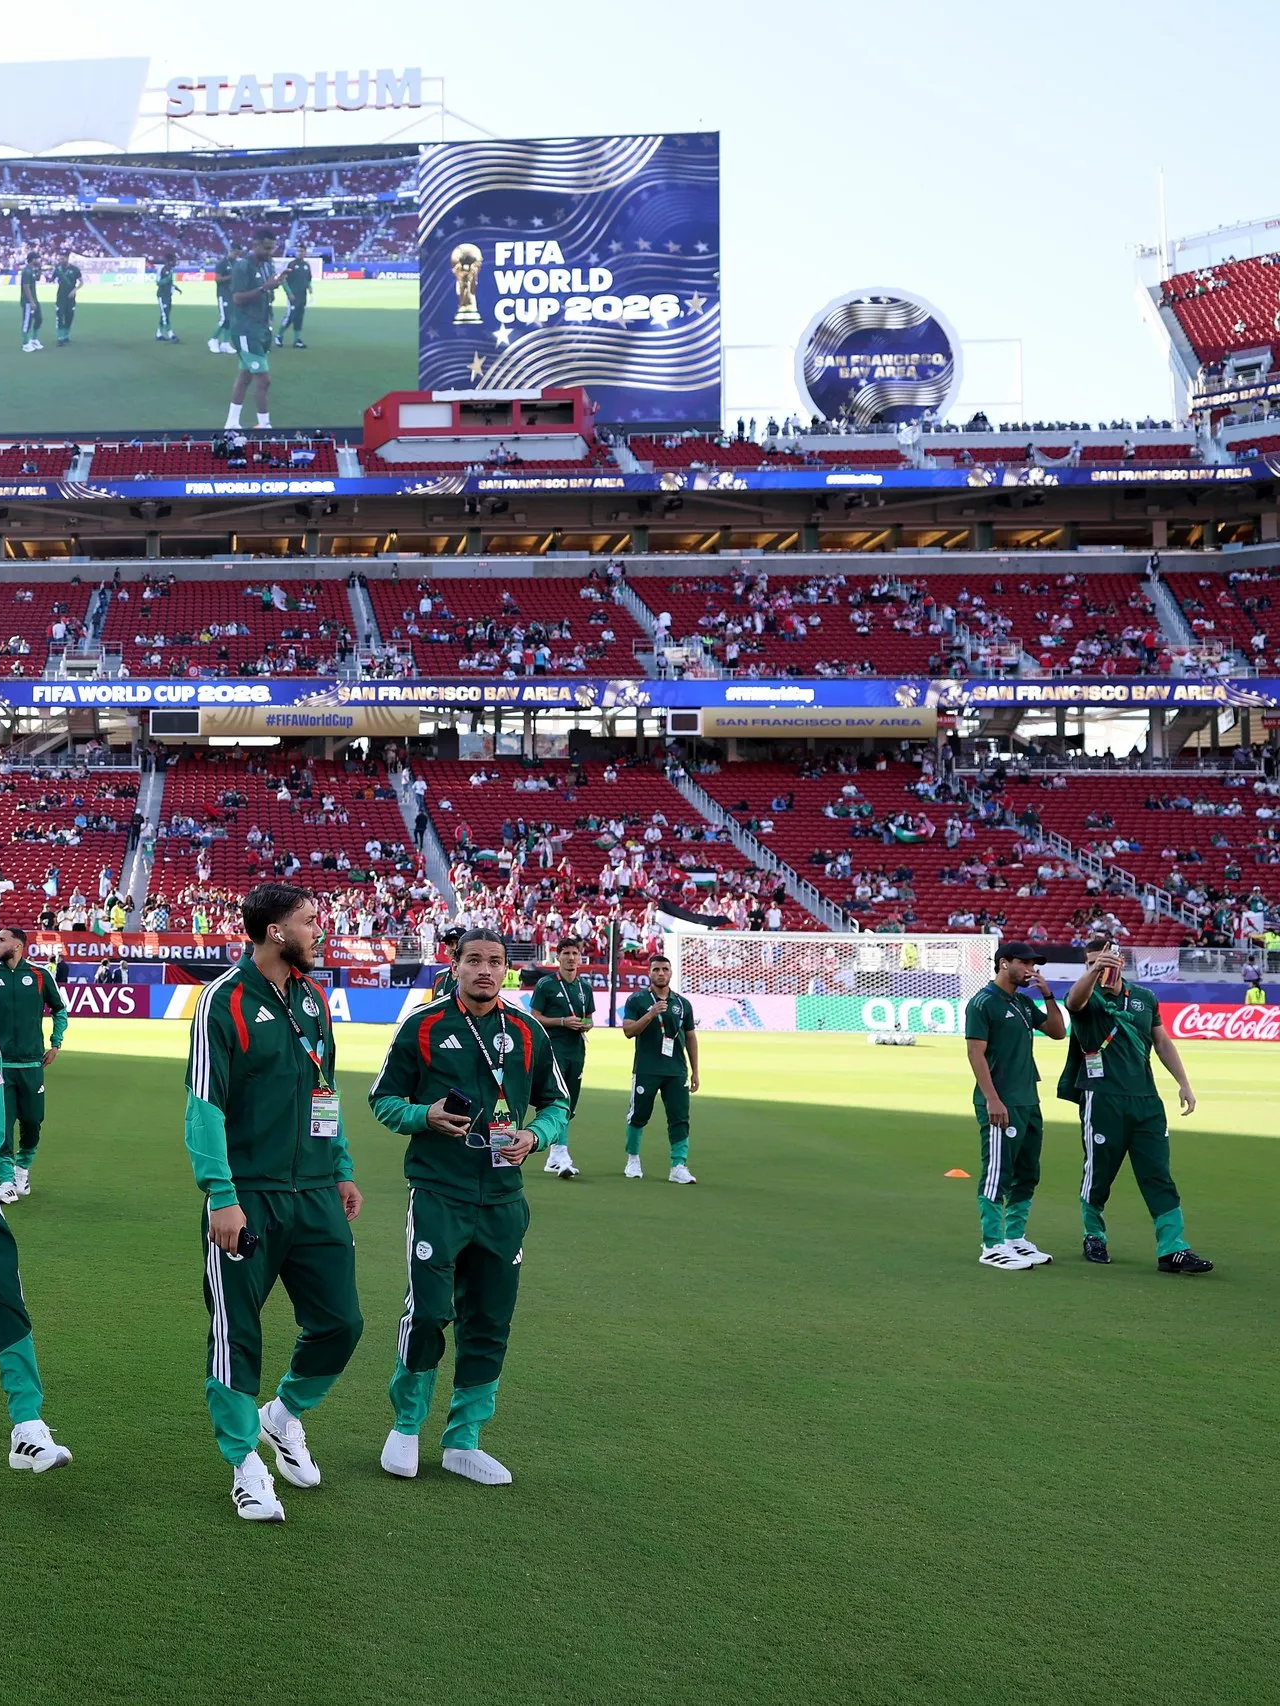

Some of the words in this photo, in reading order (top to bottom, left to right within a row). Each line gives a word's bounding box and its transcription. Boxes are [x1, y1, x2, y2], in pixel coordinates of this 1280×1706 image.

[166, 68, 422, 117] STADIUM
[495, 240, 564, 266] FIFA
[494, 268, 613, 294] WORLD
[494, 298, 560, 323] CUP
[564, 294, 683, 321] 2026
[815, 355, 847, 367] SAN
[851, 353, 944, 366] FRANCISCO
[839, 366, 870, 378] BAY
[874, 365, 918, 378] AREA
[1240, 387, 1266, 400] BAY
[1091, 471, 1117, 482] SAN
[1118, 470, 1189, 481] FRANCISCO
[1190, 469, 1215, 480] BAY
[1216, 467, 1252, 479] AREA
[19, 486, 47, 497] AREA
[185, 480, 213, 495] FIFA
[214, 480, 260, 495] WORLD
[261, 480, 288, 495] CUP
[478, 480, 500, 490] SAN
[501, 478, 568, 490] FRANCISCO
[569, 478, 592, 489] BAY
[593, 478, 624, 489] AREA
[33, 685, 72, 703] FIFA
[73, 685, 151, 703] WORLD
[154, 685, 195, 703] CUP
[197, 685, 272, 703] 2026
[338, 686, 376, 702] SAN
[378, 686, 481, 702] FRANCISCO
[483, 686, 519, 702] BAY
[523, 686, 571, 702] AREA
[973, 685, 1014, 701] SAN
[1016, 685, 1129, 701] FRANCISCO
[1132, 685, 1171, 701] BAY
[1174, 685, 1226, 701] AREA
[265, 713, 353, 728] #FIFAWorldCup
[716, 718, 748, 727] SAN
[752, 718, 842, 727] FRANCISCO
[845, 718, 876, 727] BAY
[879, 718, 923, 727] AREA
[330, 938, 350, 947] One
[28, 943, 63, 956] ONE
[67, 942, 113, 957] TEAM
[119, 945, 153, 958] ONE
[158, 945, 220, 960] DREAM
[333, 950, 353, 960] One
[1172, 1003, 1280, 1039] Coca-Cola
